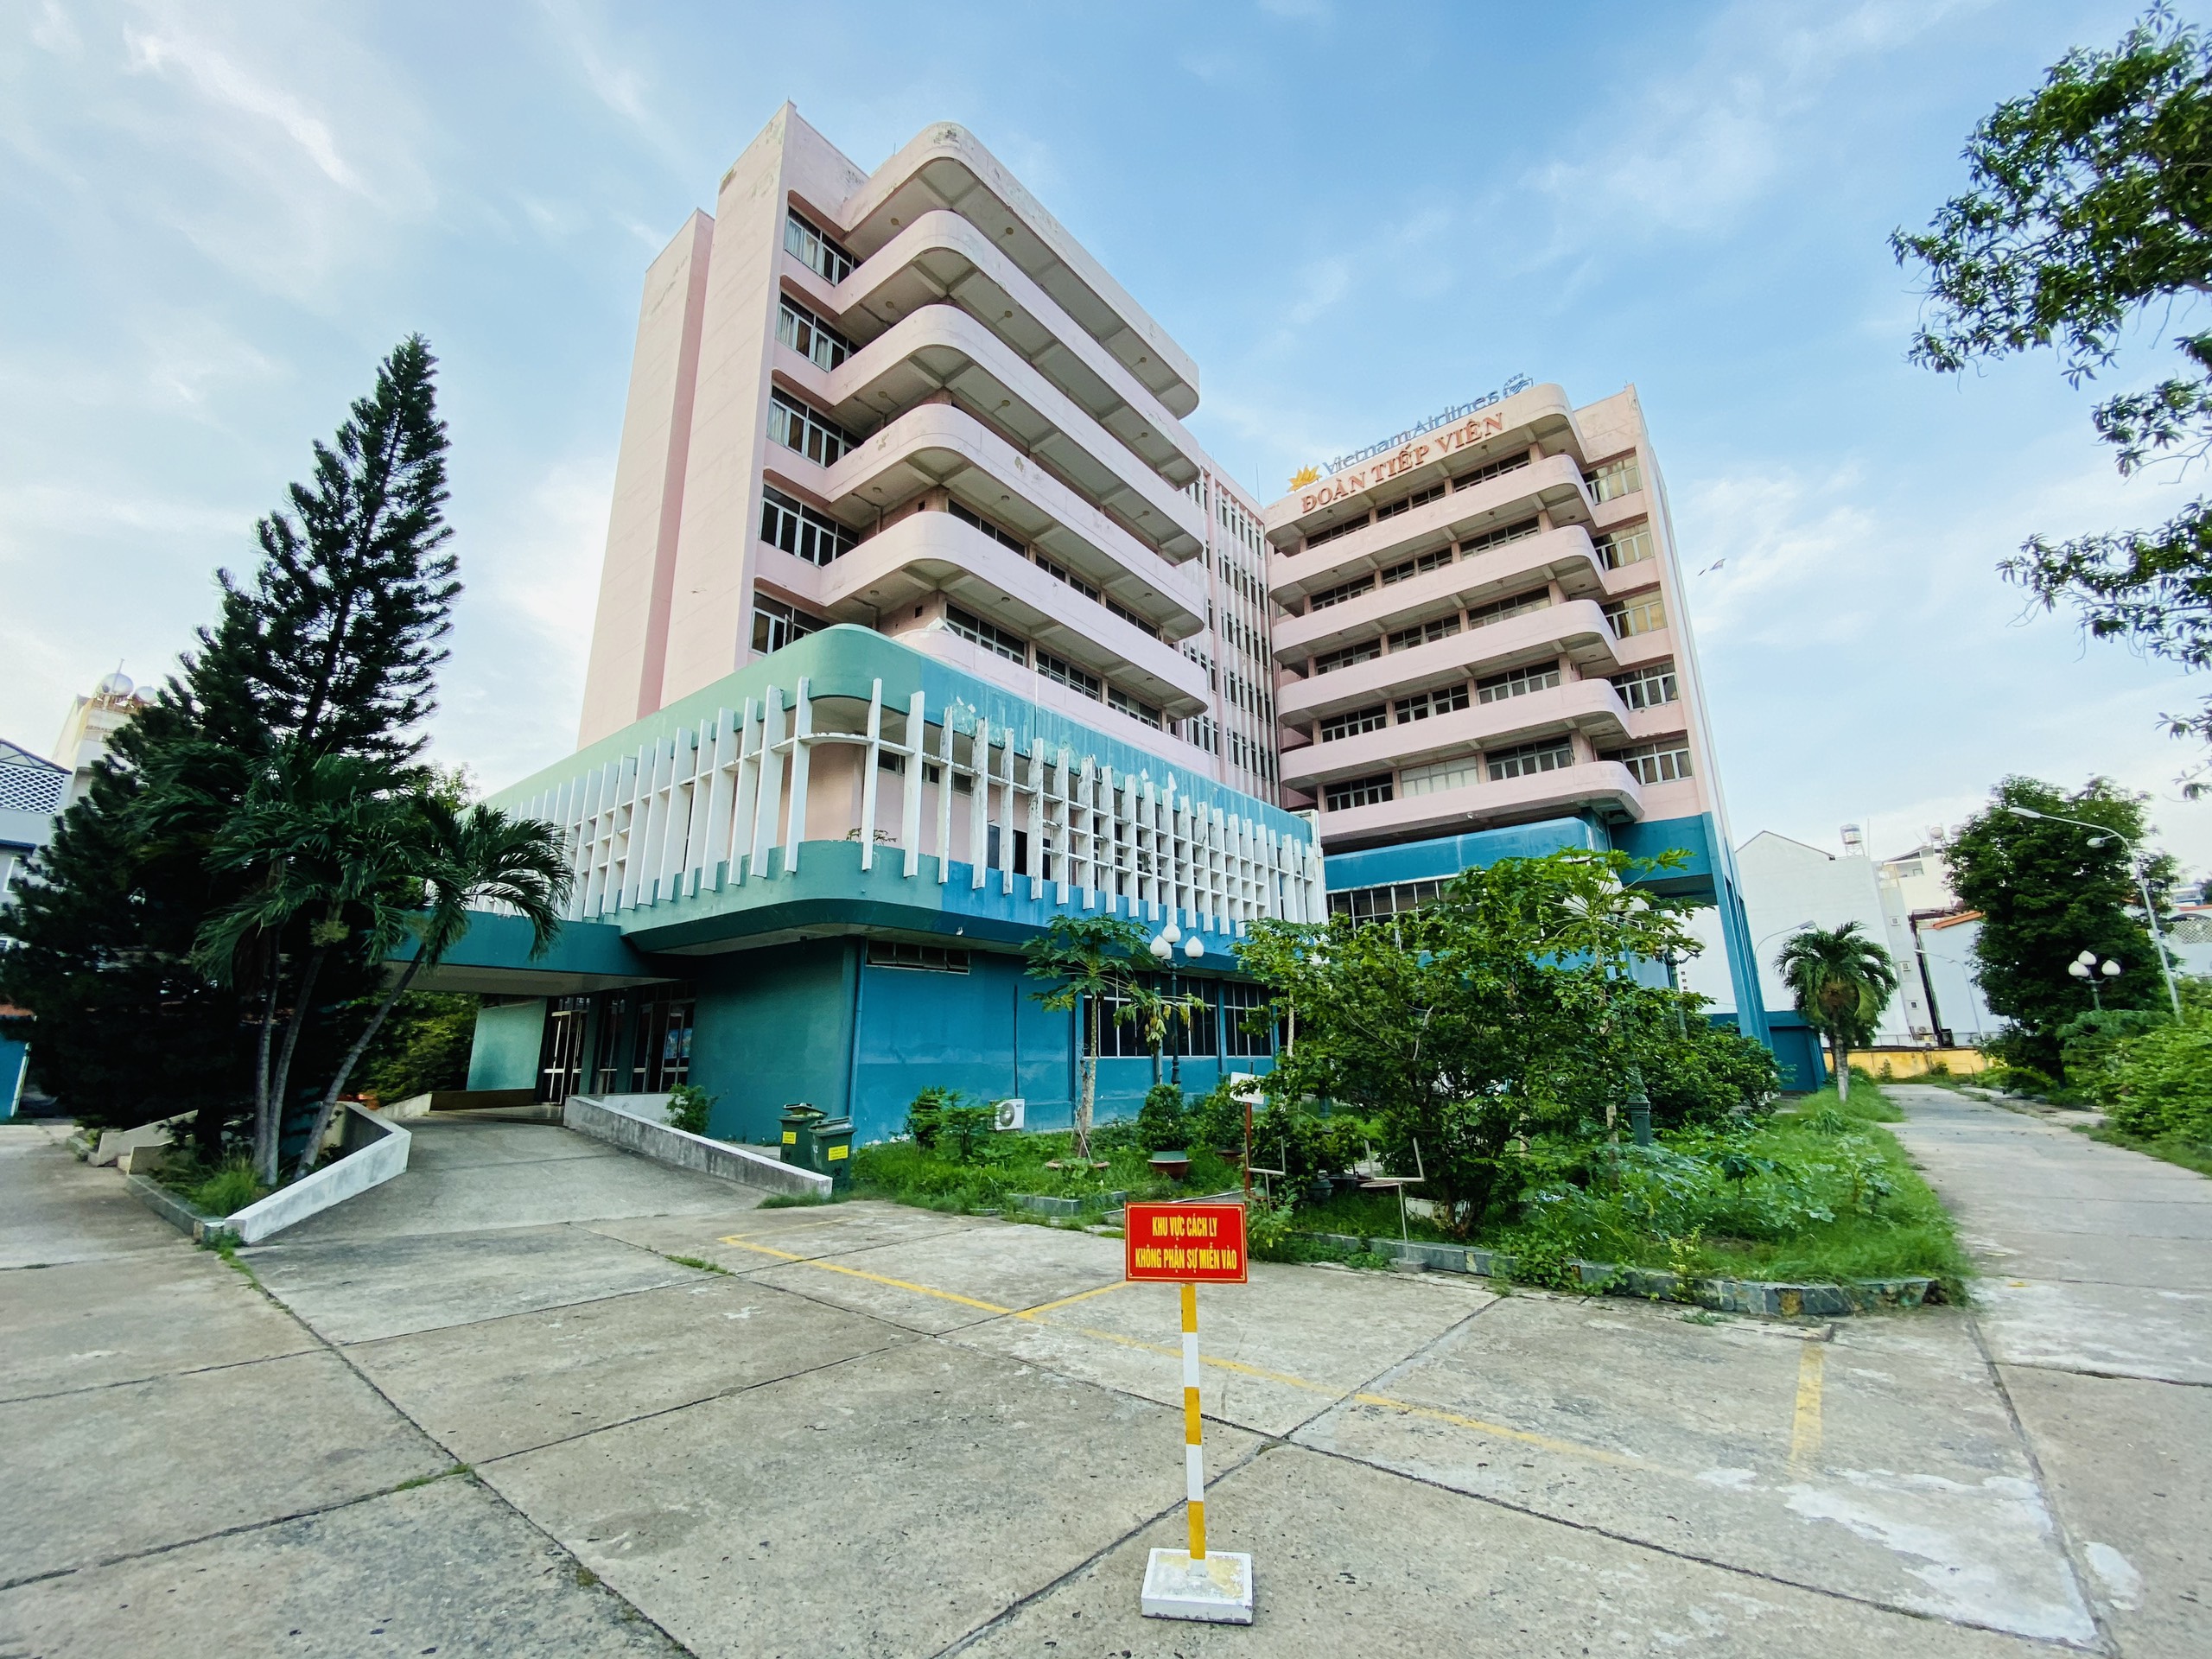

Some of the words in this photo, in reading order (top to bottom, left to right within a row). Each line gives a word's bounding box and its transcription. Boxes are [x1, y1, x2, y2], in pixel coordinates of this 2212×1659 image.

[1322, 430, 1412, 475] Vietnam
[1412, 390, 1500, 436] Airlines
[1300, 471, 1365, 513] ĐOÀN
[1370, 443, 1430, 482] TIẾP
[1434, 412, 1503, 453] VIÊN
[1152, 1216, 1168, 1236] KHU
[1169, 1214, 1185, 1241] VỰC
[1186, 1212, 1208, 1236] CÁCH
[1209, 1217, 1217, 1236] LY
[1135, 1243, 1162, 1268] KHÔNG
[1163, 1244, 1185, 1273] PHẬN
[1186, 1247, 1198, 1274] SỰ
[1199, 1242, 1220, 1269] MIỄN
[1221, 1244, 1237, 1269] VÀO
